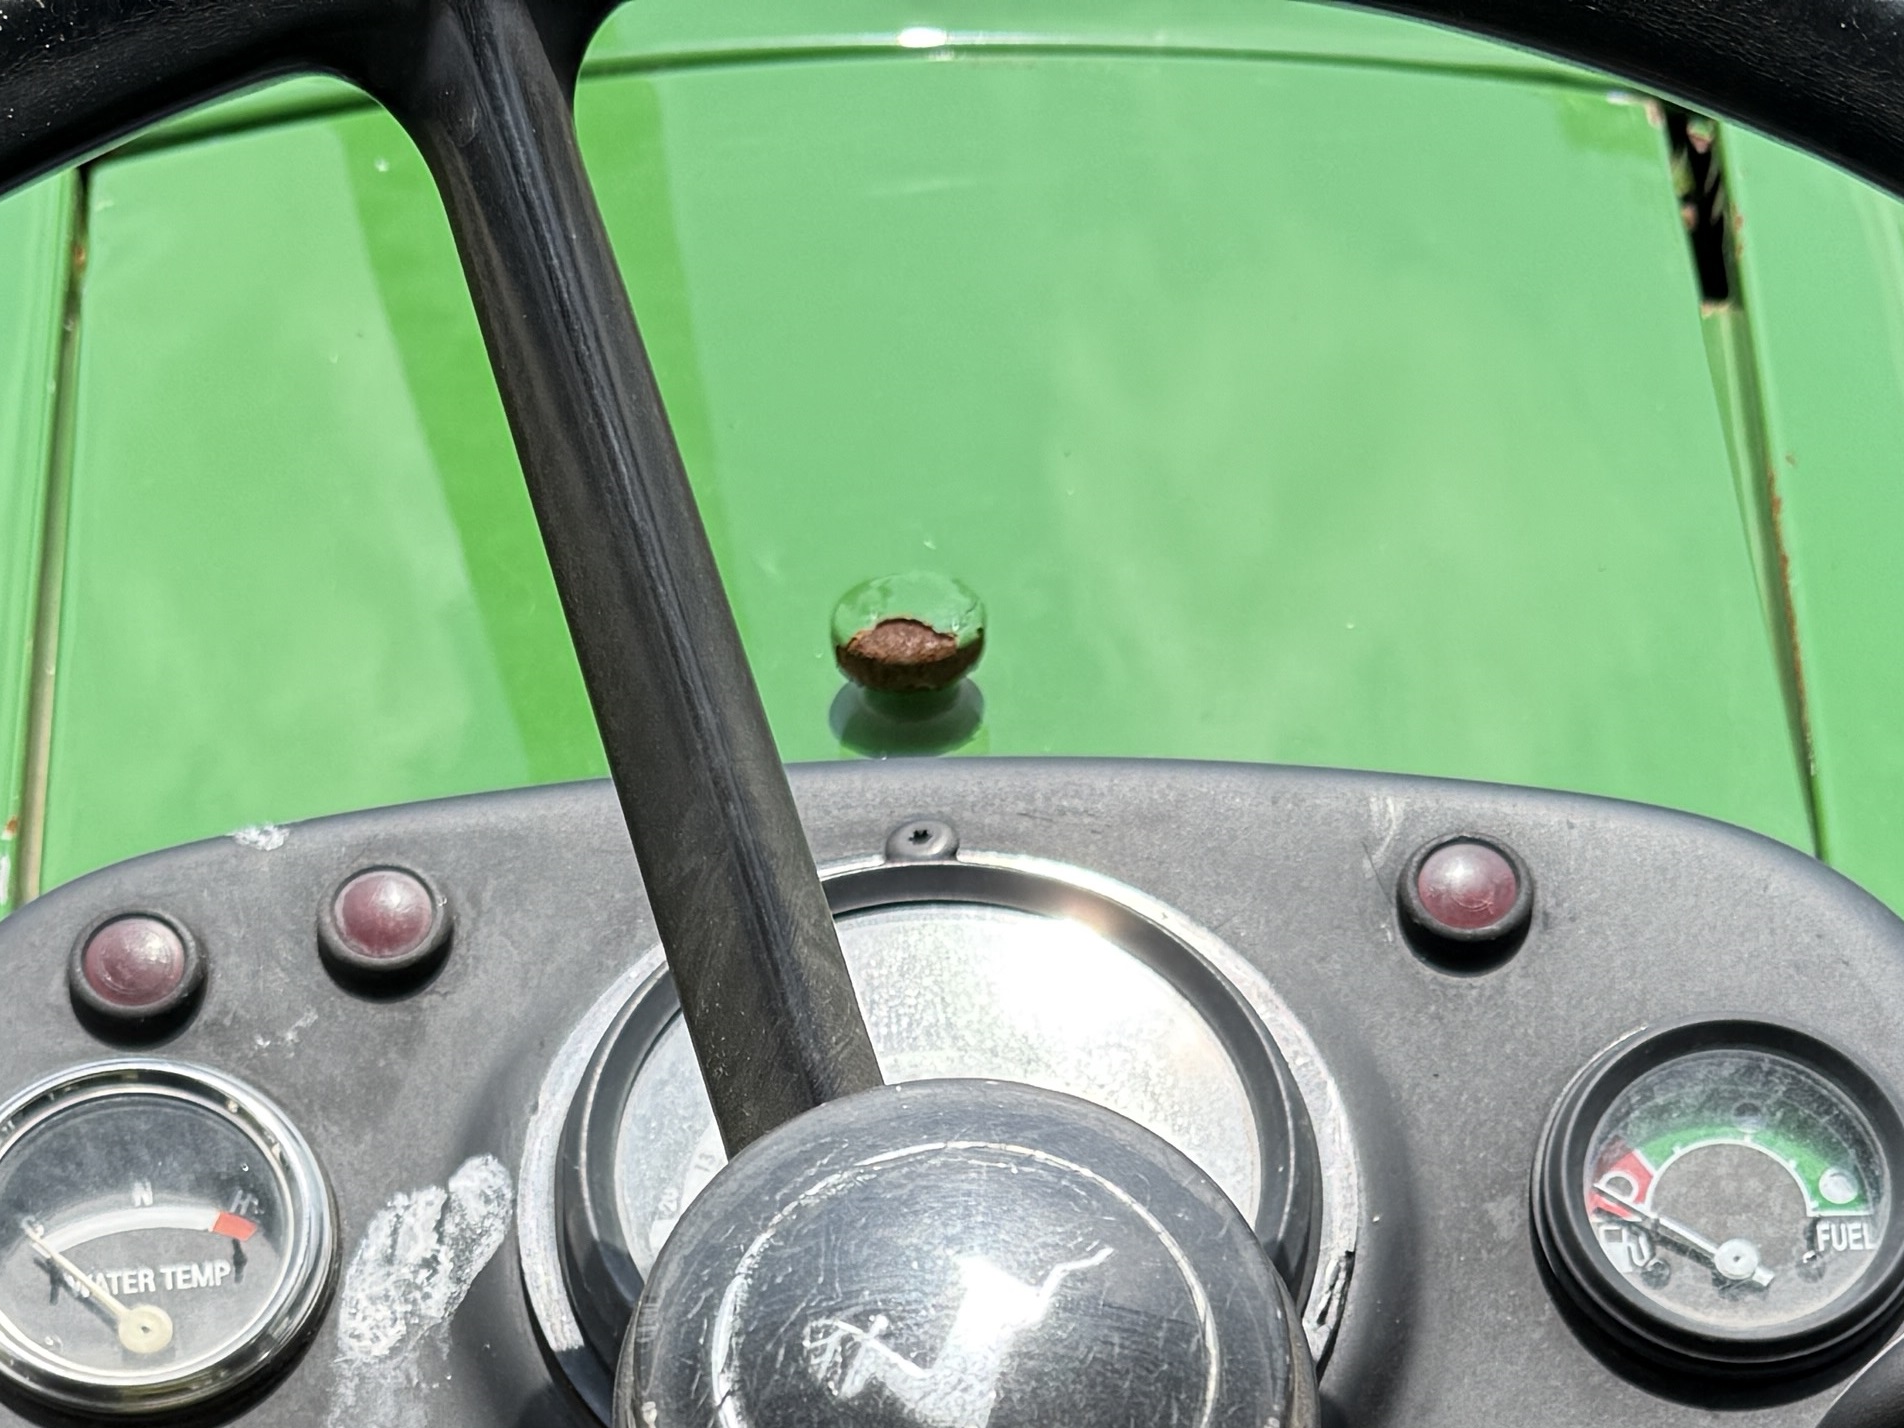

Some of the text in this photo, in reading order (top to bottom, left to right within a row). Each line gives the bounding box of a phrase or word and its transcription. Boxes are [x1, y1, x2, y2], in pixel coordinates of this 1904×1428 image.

[132, 1180, 154, 1207] N
[228, 1189, 253, 1216] H
[1815, 1220, 1876, 1251] FUEL
[159, 1258, 232, 1292] TEMP
